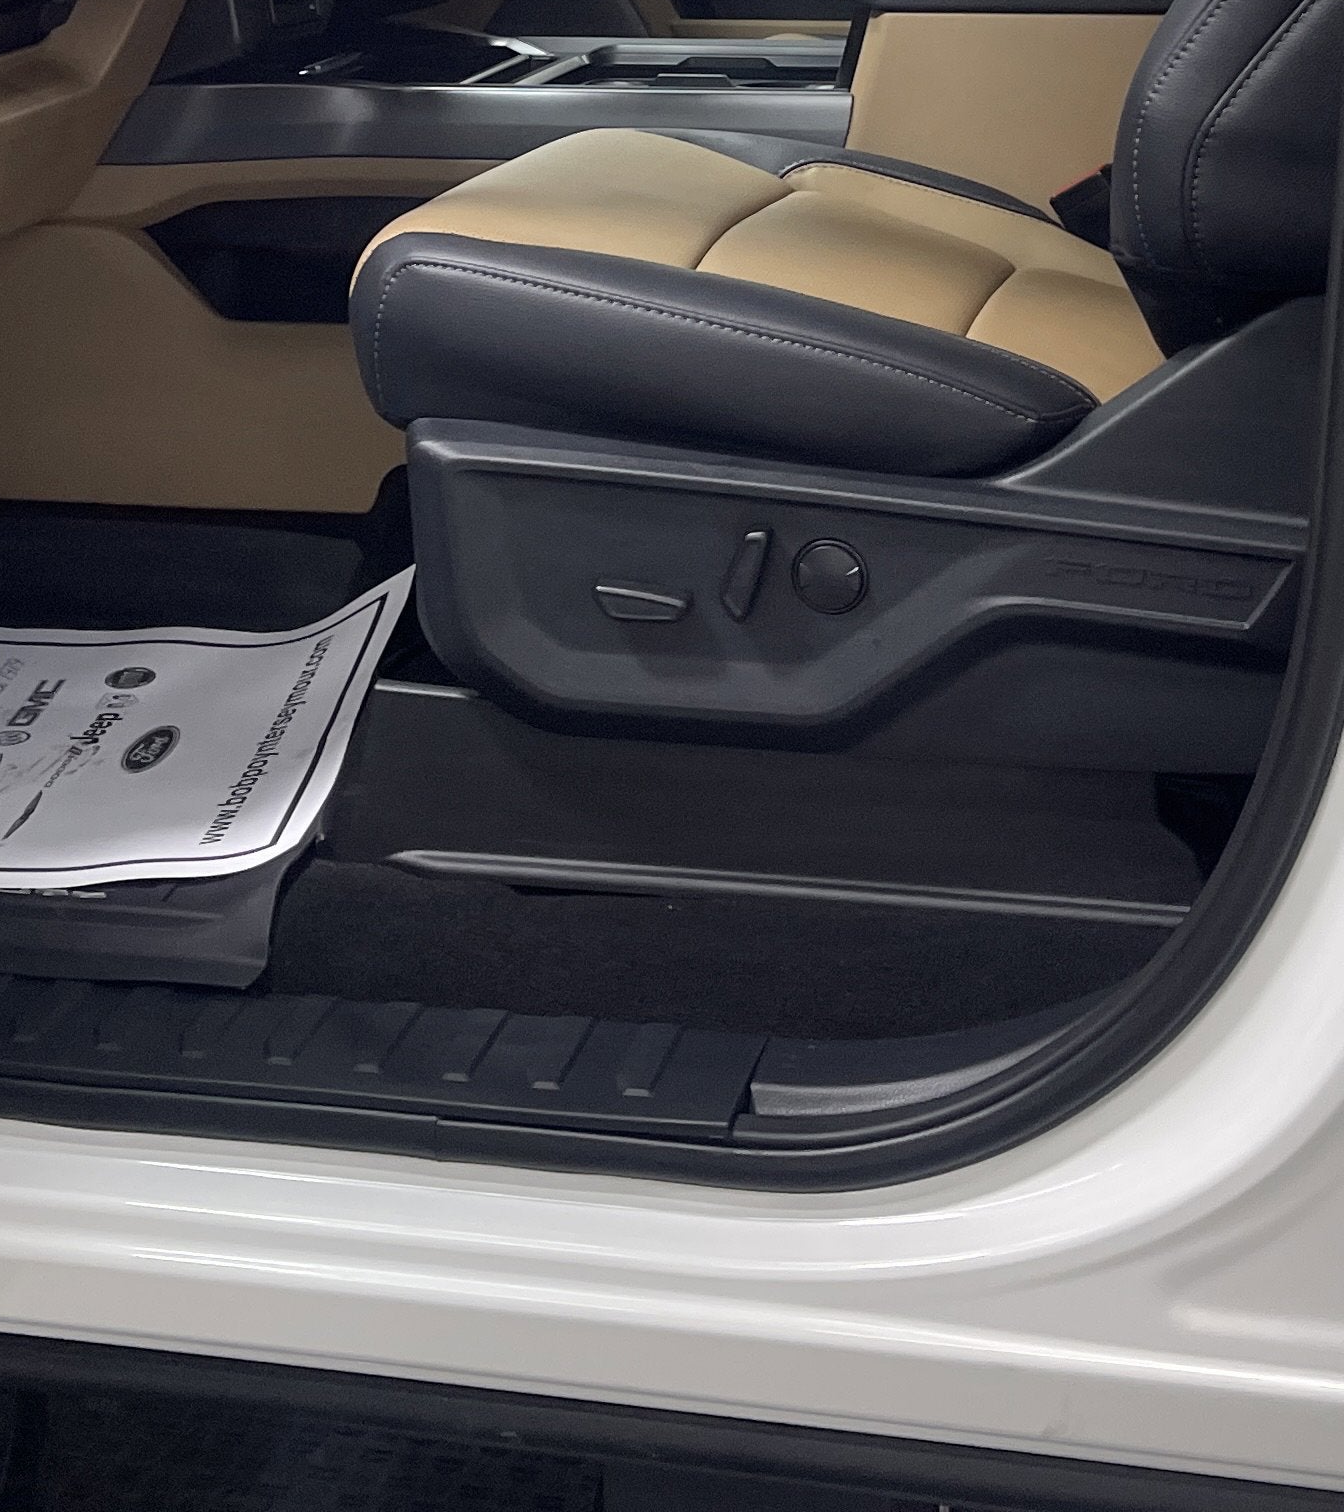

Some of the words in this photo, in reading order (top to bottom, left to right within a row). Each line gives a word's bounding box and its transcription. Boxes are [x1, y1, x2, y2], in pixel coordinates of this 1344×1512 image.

[7, 678, 67, 727] GMC
[69, 712, 124, 746] Jeep
[127, 733, 174, 765] Ford
[198, 634, 335, 846] www.bobpoynterseymour.com
